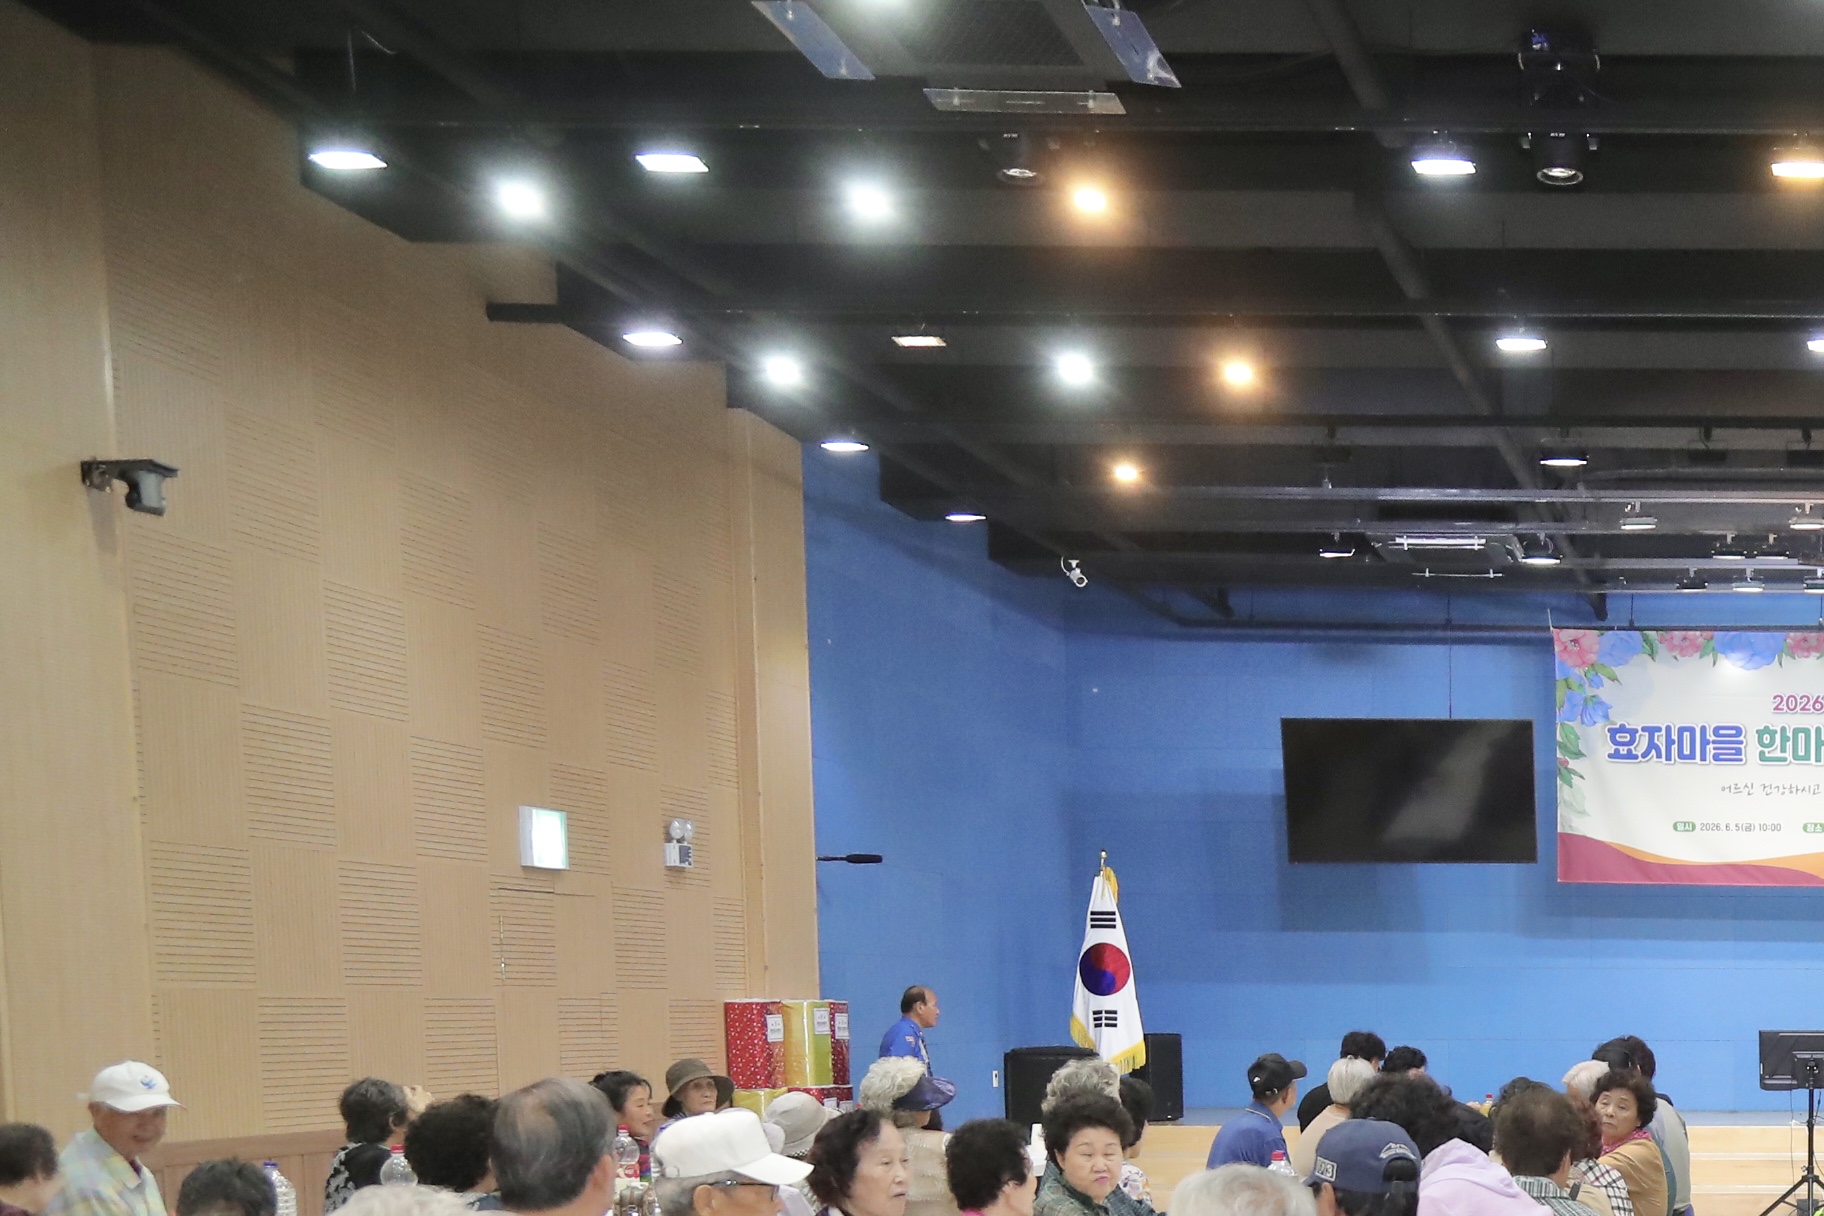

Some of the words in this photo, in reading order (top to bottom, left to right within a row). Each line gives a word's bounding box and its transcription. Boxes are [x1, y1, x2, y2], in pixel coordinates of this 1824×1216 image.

[1607, 724, 1745, 763] 효자마을
[1721, 782, 1754, 796] 어르신
[1760, 783, 1822, 796] 건강하시고
[1676, 822, 1693, 832] 일시
[1700, 822, 1724, 832] 2026.
[1735, 823, 1756, 832] 5(금)
[1758, 822, 1782, 832] 10:00
